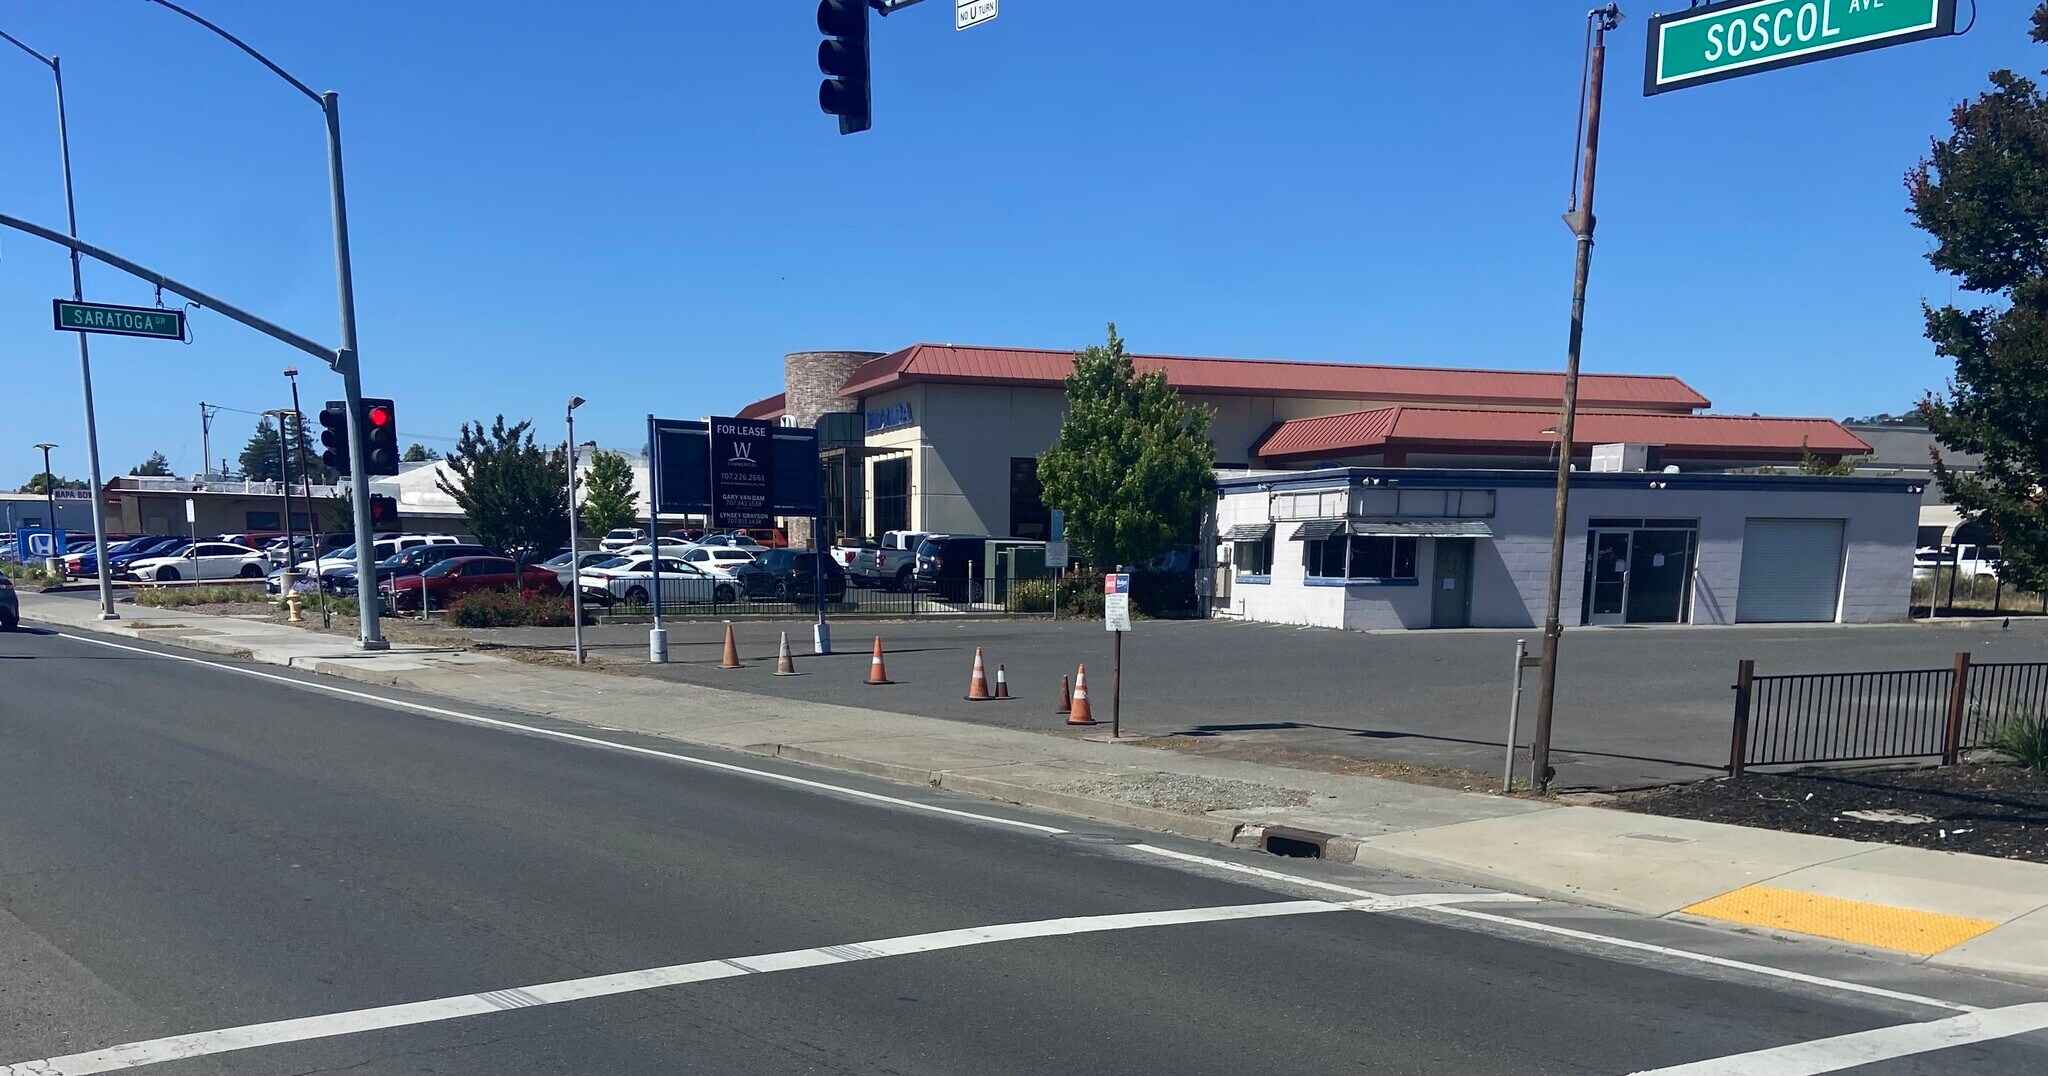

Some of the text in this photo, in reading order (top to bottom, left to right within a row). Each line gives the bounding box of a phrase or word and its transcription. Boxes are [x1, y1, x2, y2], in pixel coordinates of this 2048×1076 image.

[960, 2, 994, 21] NO U TURN
[1704, 0, 1840, 62] SOSCOL
[74, 309, 165, 330] SARATOGA DR
[717, 424, 766, 436] FOR LEASE
[733, 442, 751, 457] W
